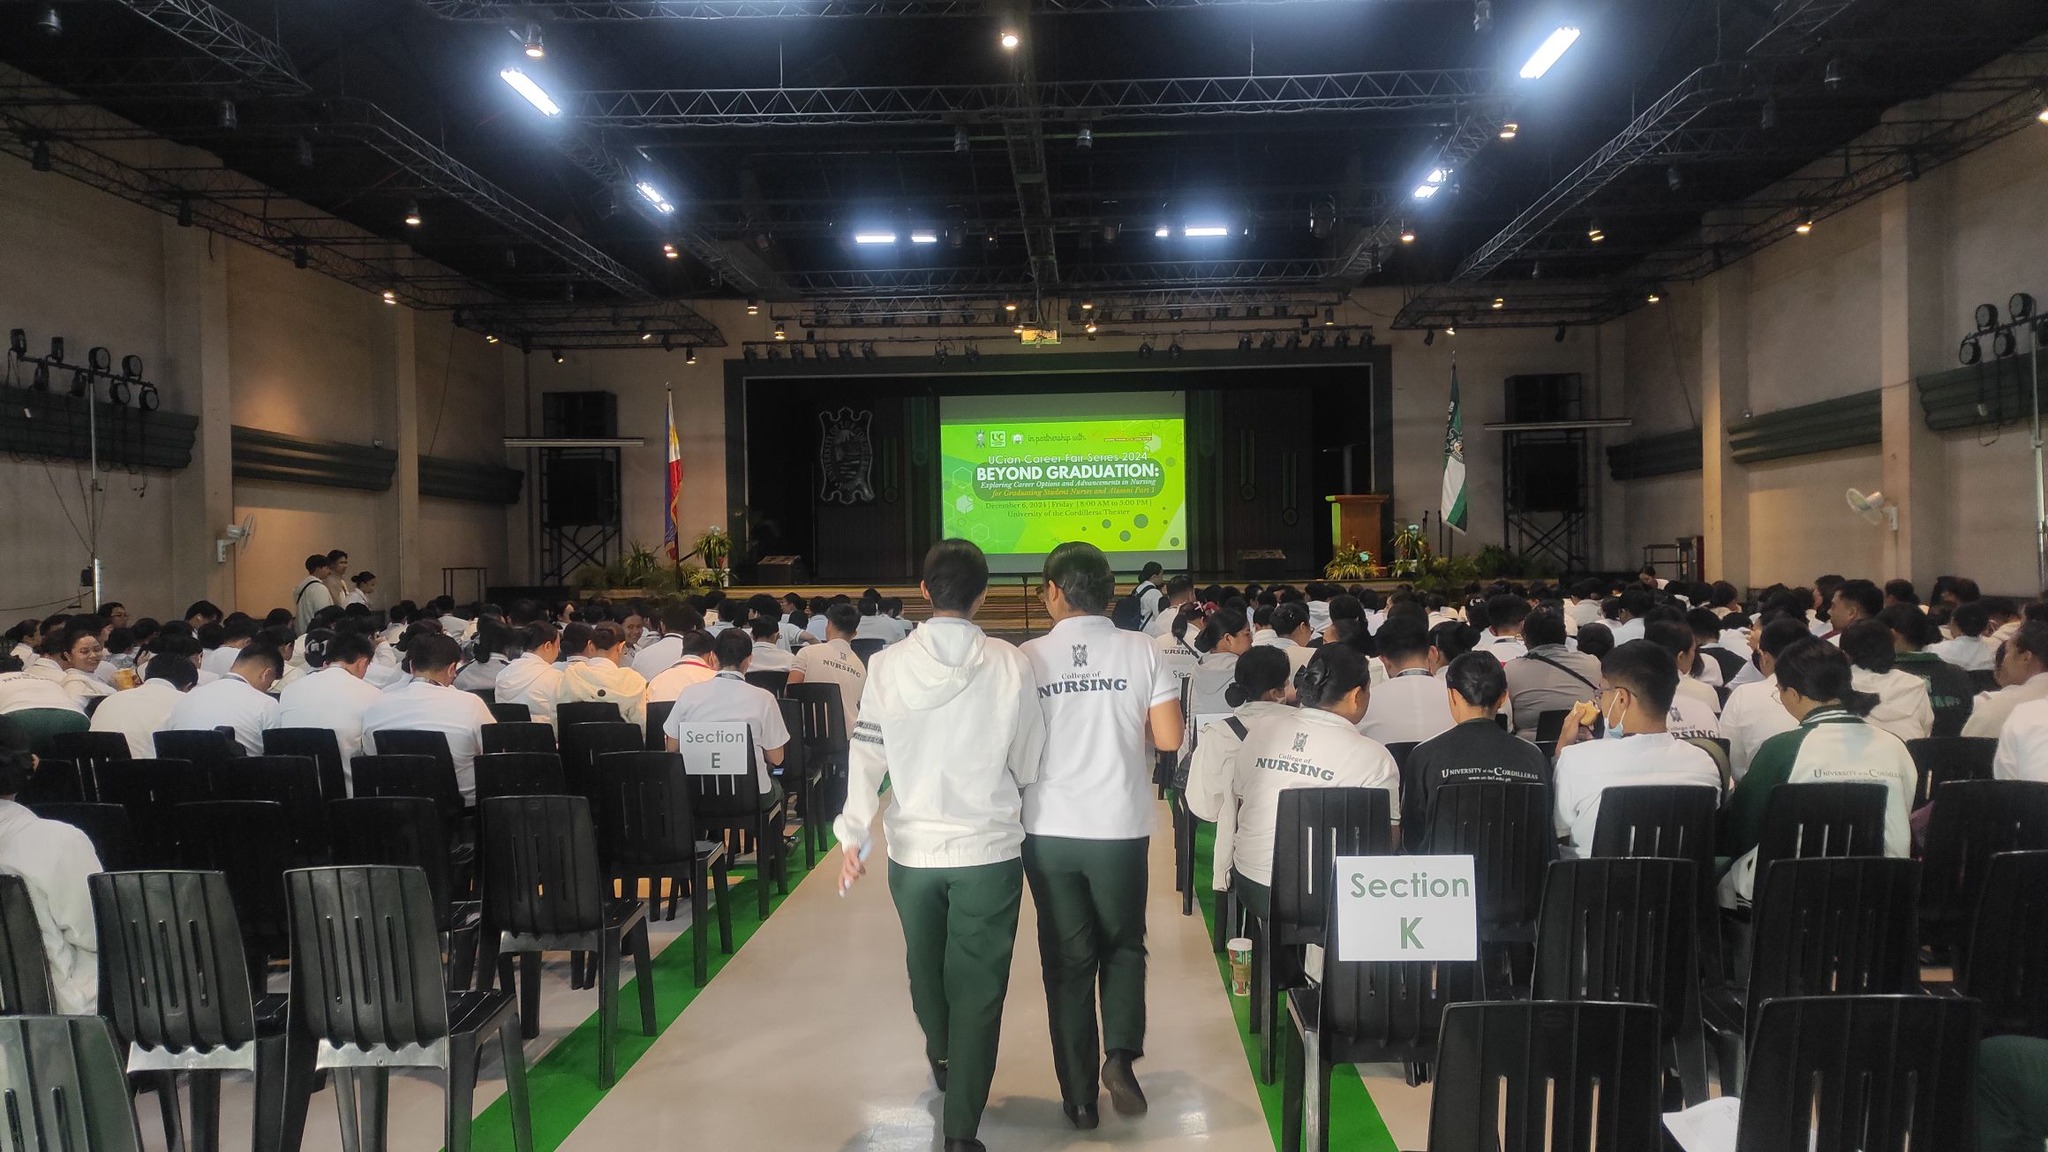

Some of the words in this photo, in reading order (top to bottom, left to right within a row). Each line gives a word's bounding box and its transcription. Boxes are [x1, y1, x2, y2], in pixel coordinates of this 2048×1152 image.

[1035, 433, 1071, 445] partnership
[988, 455, 1020, 465] UCian
[1024, 454, 1061, 464] Career
[1065, 453, 1083, 463] Fair
[1087, 452, 1119, 462] Series
[1122, 451, 1148, 461] 2024
[976, 466, 1043, 481] BEYOND
[1046, 463, 1159, 480] GRADUATION:
[980, 481, 1012, 490] Exploring
[1036, 480, 1060, 490] Options
[1061, 479, 1074, 487] and
[1075, 479, 1120, 487] Advancements
[1130, 478, 1157, 487] Nursing
[991, 488, 1002, 498] for
[1003, 489, 1041, 498] Graduating
[1043, 488, 1069, 496] Student
[1051, 501, 1074, 509] Friday
[1007, 510, 1043, 518] University
[1064, 509, 1102, 517] Cordilleras
[822, 659, 861, 678] NURSING
[1061, 671, 1091, 680] College
[1092, 670, 1102, 678] of
[1037, 678, 1128, 699] NURSING
[686, 729, 744, 743] Section
[711, 752, 721, 769] E
[1278, 753, 1303, 763] College
[1255, 757, 1335, 781] NURSING
[1350, 872, 1470, 898] Section
[1400, 916, 1425, 949] K
